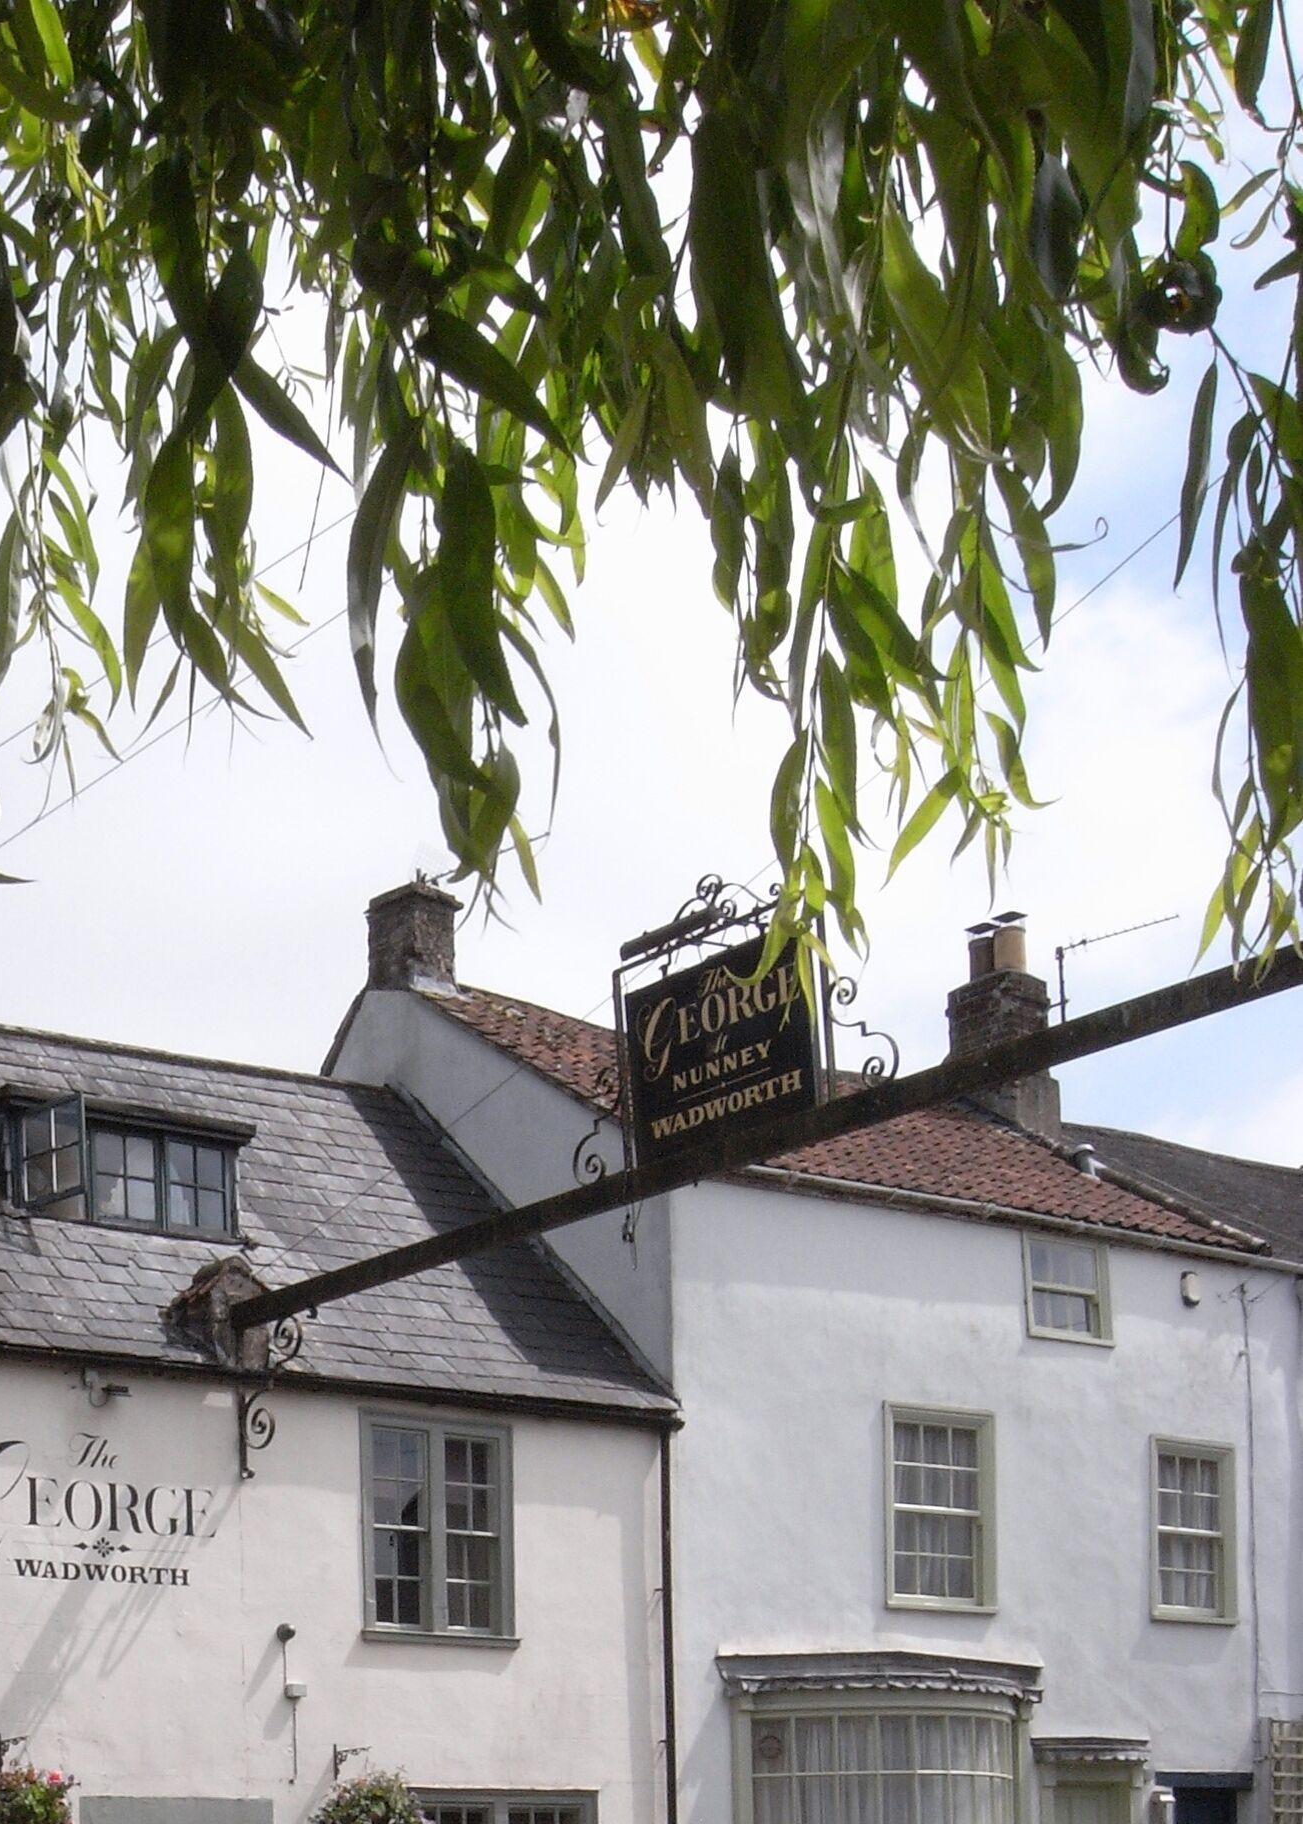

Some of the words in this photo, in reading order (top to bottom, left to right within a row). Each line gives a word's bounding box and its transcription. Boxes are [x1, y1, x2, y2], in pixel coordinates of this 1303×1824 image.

[636, 962, 801, 1082] GEORGE
[672, 1039, 772, 1092] NUNNEY
[651, 1068, 803, 1140] WADWORTH
[69, 1432, 120, 1470] The
[14, 1558, 191, 1587] WADWORTH
